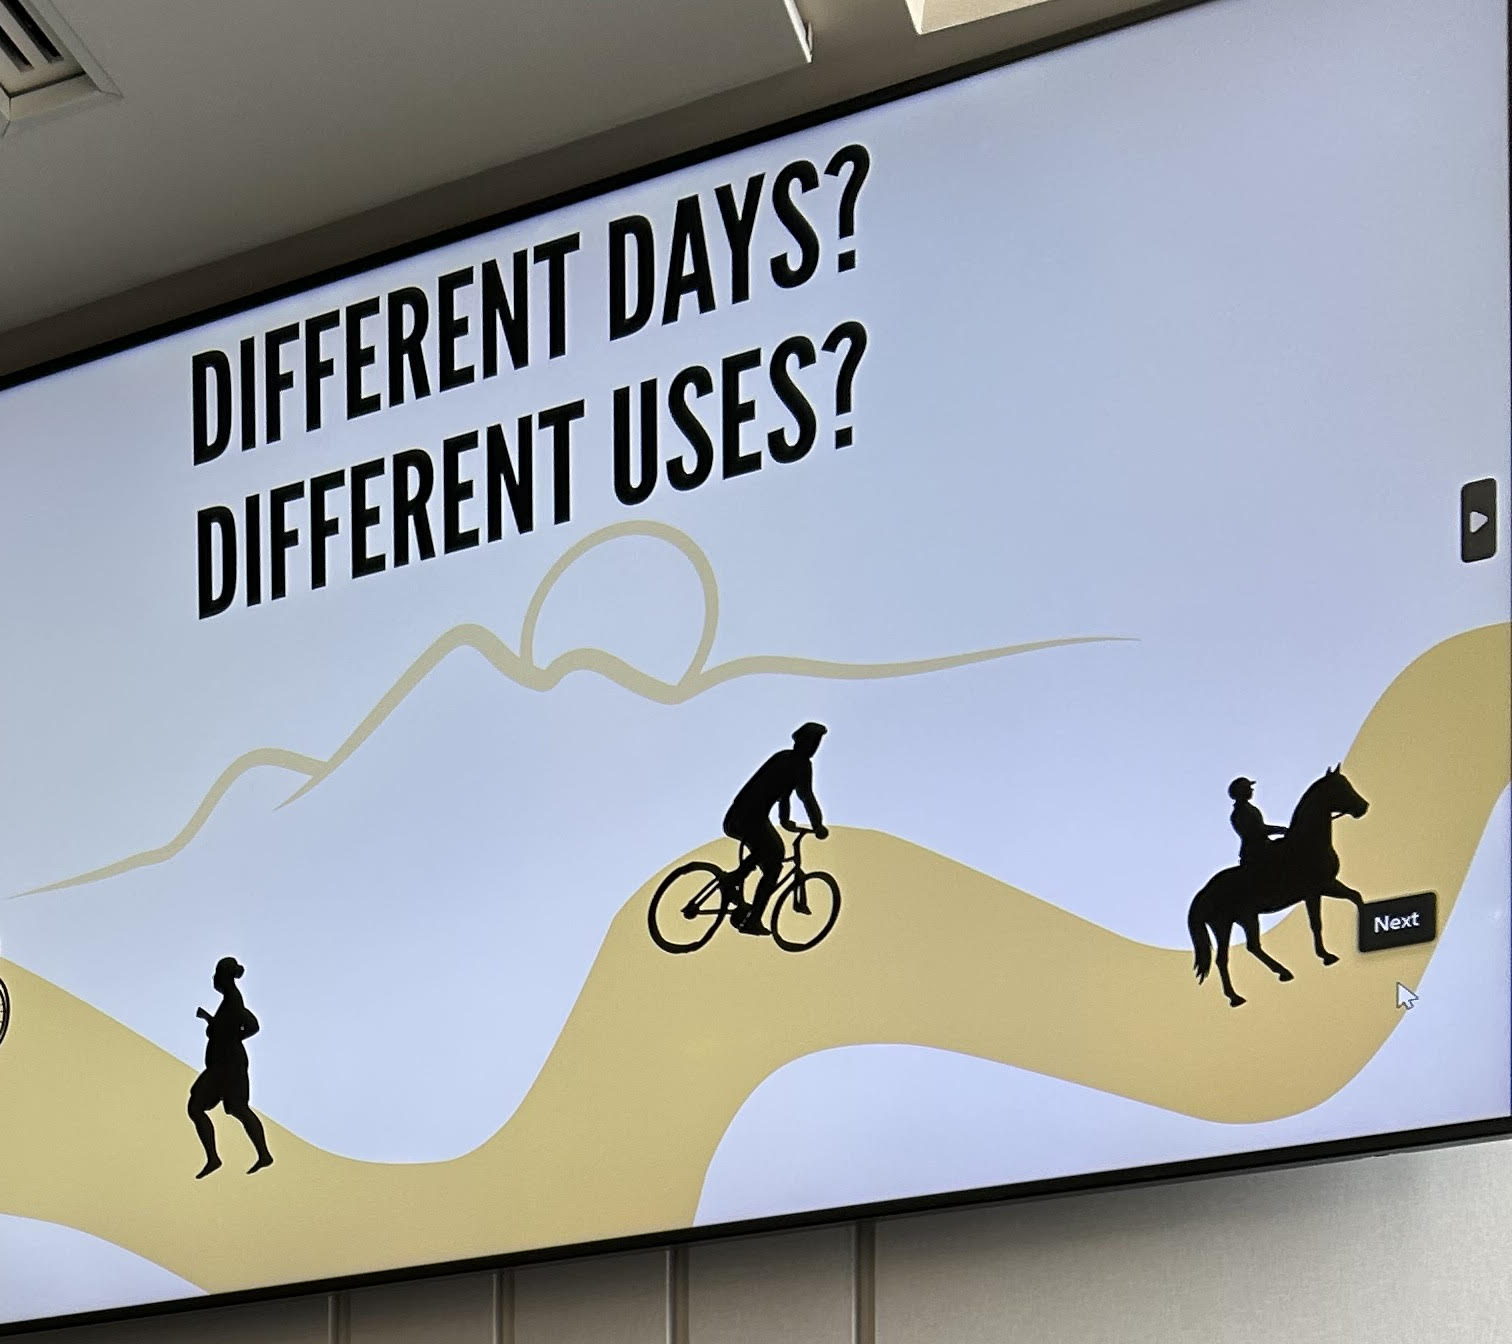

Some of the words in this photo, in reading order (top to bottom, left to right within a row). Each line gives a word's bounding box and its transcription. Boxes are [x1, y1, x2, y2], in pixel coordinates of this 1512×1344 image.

[191, 231, 580, 466] DIFFERENT
[608, 144, 871, 341] DAYS?
[197, 399, 585, 620] DIFFERENT
[612, 320, 869, 507] USES?
[1374, 911, 1420, 933] Next
